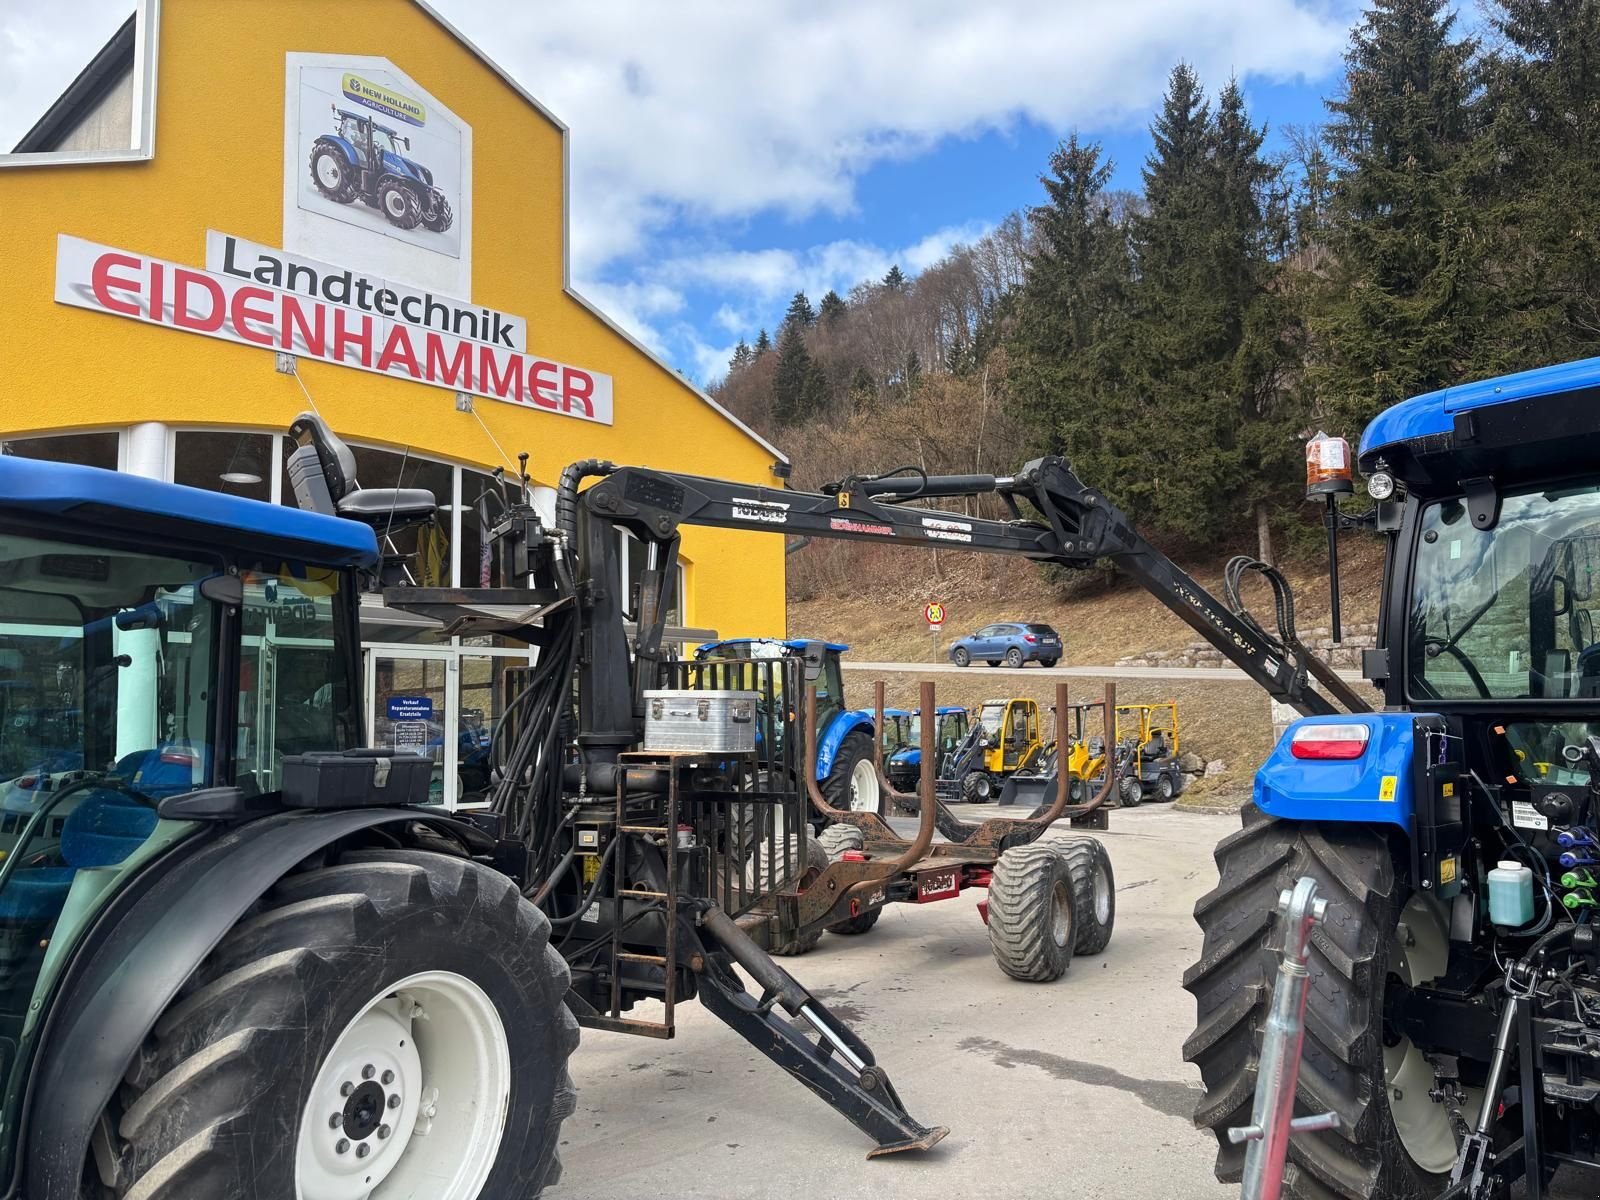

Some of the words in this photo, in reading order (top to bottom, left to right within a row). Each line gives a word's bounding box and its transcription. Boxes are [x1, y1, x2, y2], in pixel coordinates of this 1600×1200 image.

[362, 86, 382, 100] NEW
[383, 94, 420, 115] HOLLAND
[362, 98, 407, 121] AGRICULTURE
[222, 235, 515, 348] Landtechnik
[91, 251, 595, 418] EIDENHAMMER
